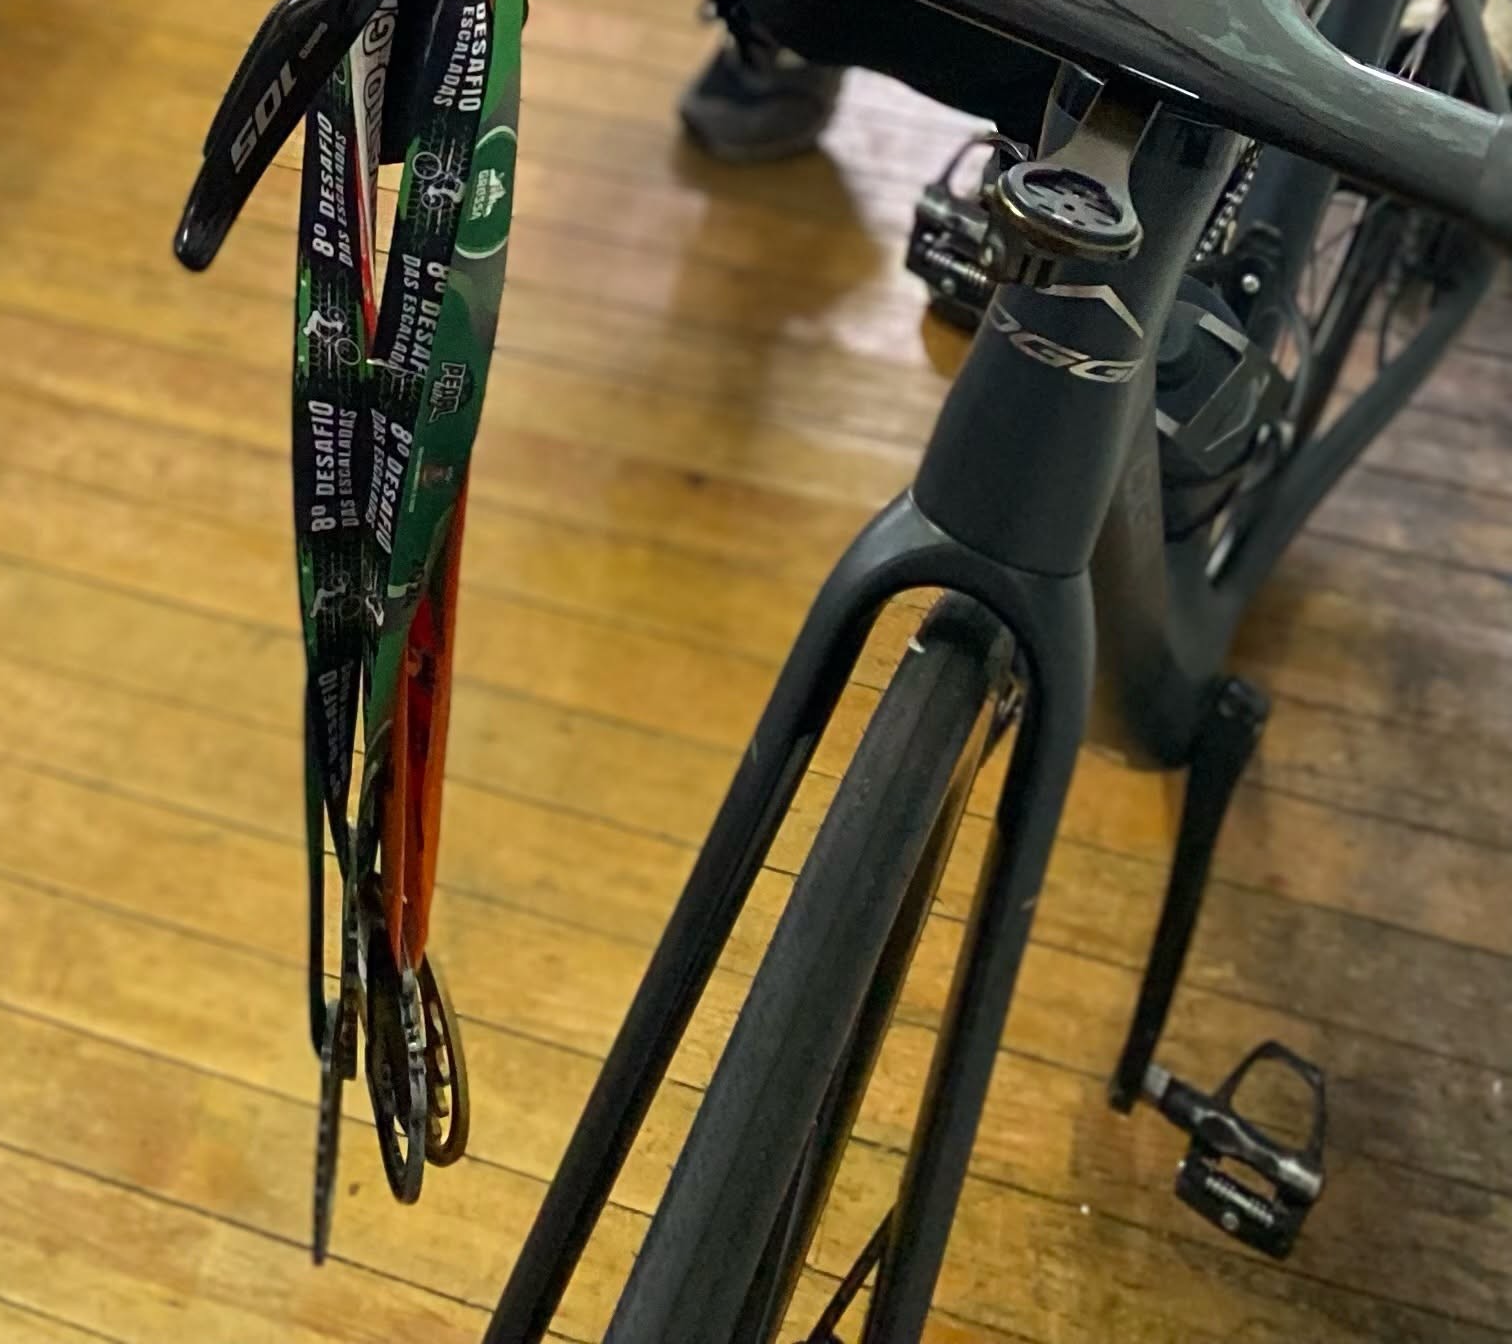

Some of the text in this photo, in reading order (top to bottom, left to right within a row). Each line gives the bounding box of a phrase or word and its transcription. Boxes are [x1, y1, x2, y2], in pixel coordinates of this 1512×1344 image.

[433, 6, 476, 108] ESCALADAS
[458, 2, 488, 112] DESAFIO
[317, 111, 336, 220] DESAFIO
[334, 131, 355, 269] DAS ESCALADAS
[388, 253, 422, 371] DAS ESCALADA
[308, 399, 335, 496] DESAFIO
[338, 408, 360, 528] DAS ESCALADAS
[370, 407, 387, 445] DAS
[376, 455, 404, 555] DESAFIO
